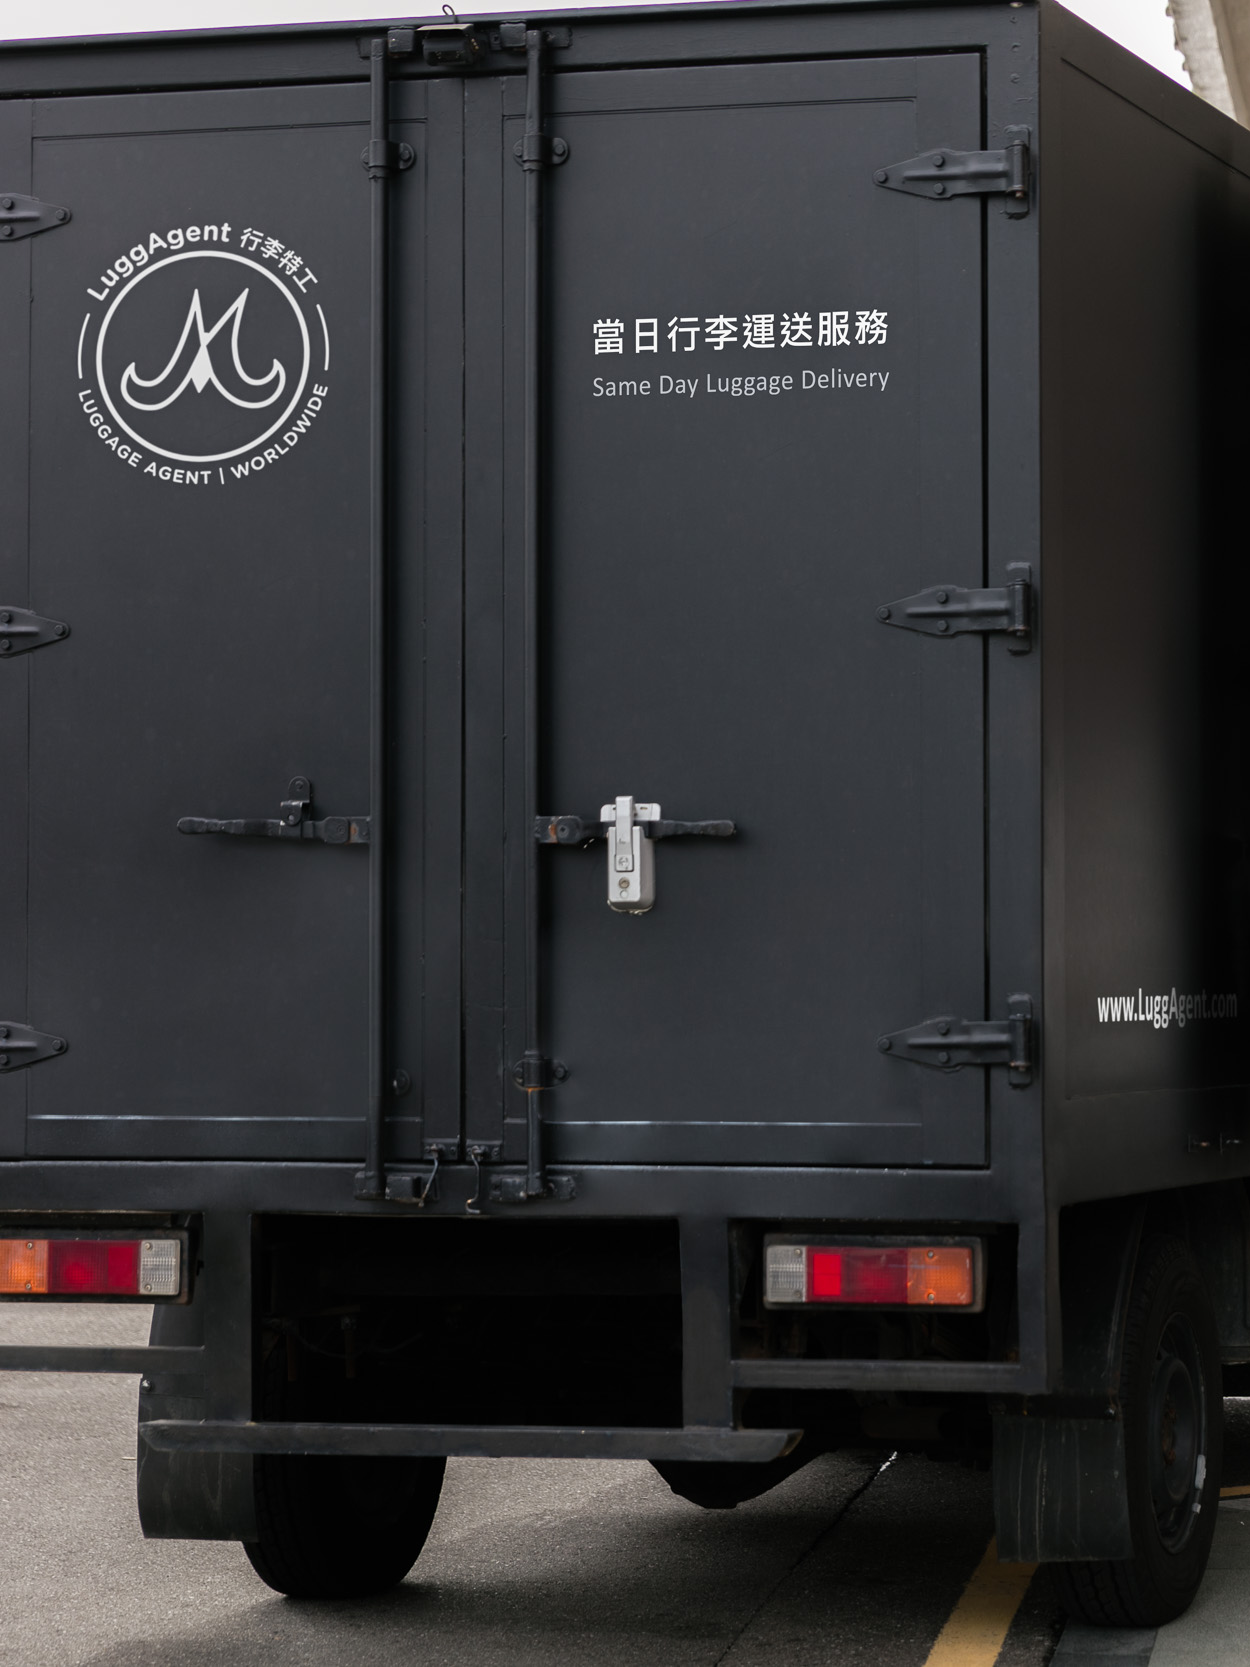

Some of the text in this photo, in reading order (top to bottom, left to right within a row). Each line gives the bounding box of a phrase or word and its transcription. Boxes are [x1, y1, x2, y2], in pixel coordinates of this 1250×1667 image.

[87, 222, 319, 301] LuggAgent 行李特工
[592, 308, 889, 355] 當日行李運送服務
[592, 367, 890, 398] Same Day Luggage Delivery
[78, 389, 144, 468] LUGGAGE
[143, 461, 212, 485] AGENT
[230, 383, 329, 480] WORLDWIDE
[1097, 987, 1238, 1029] www.LuggAgent.com
